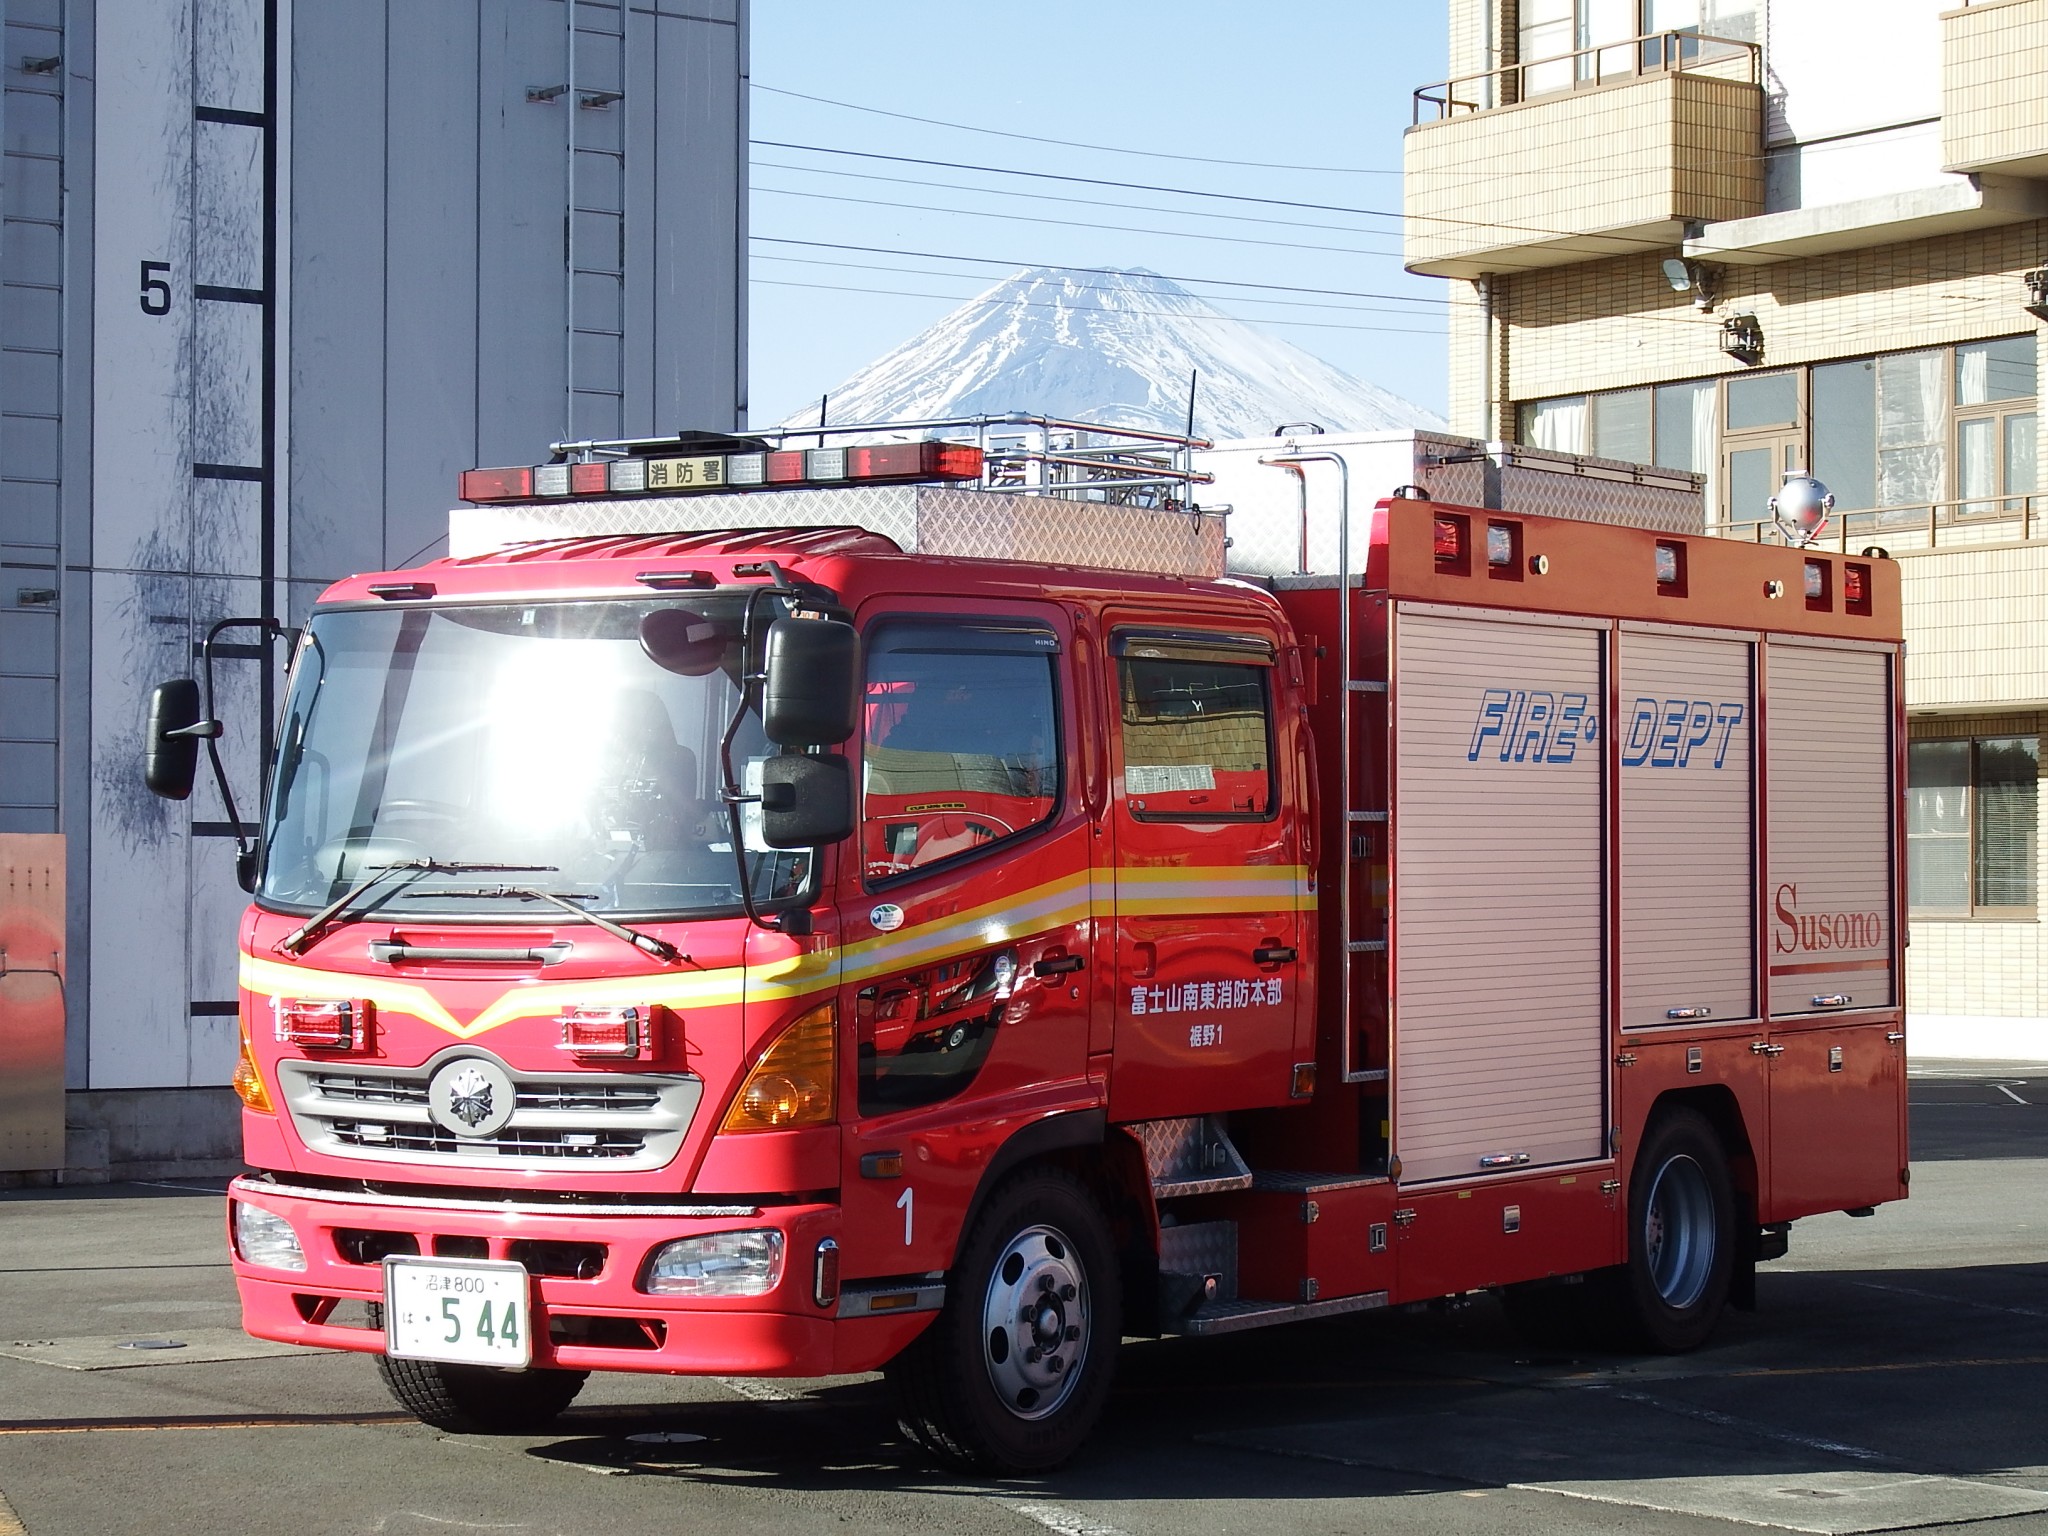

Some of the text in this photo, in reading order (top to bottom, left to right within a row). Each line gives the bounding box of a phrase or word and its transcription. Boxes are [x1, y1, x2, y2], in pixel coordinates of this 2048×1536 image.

[140, 260, 171, 316] 5
[651, 460, 720, 485] 消防署
[1035, 639, 1055, 647] HINO
[1621, 697, 1744, 769] DEPT
[1775, 882, 1881, 954] Susono
[1130, 977, 1283, 1015] 富士山南東消防本部
[896, 1186, 913, 1246] 1
